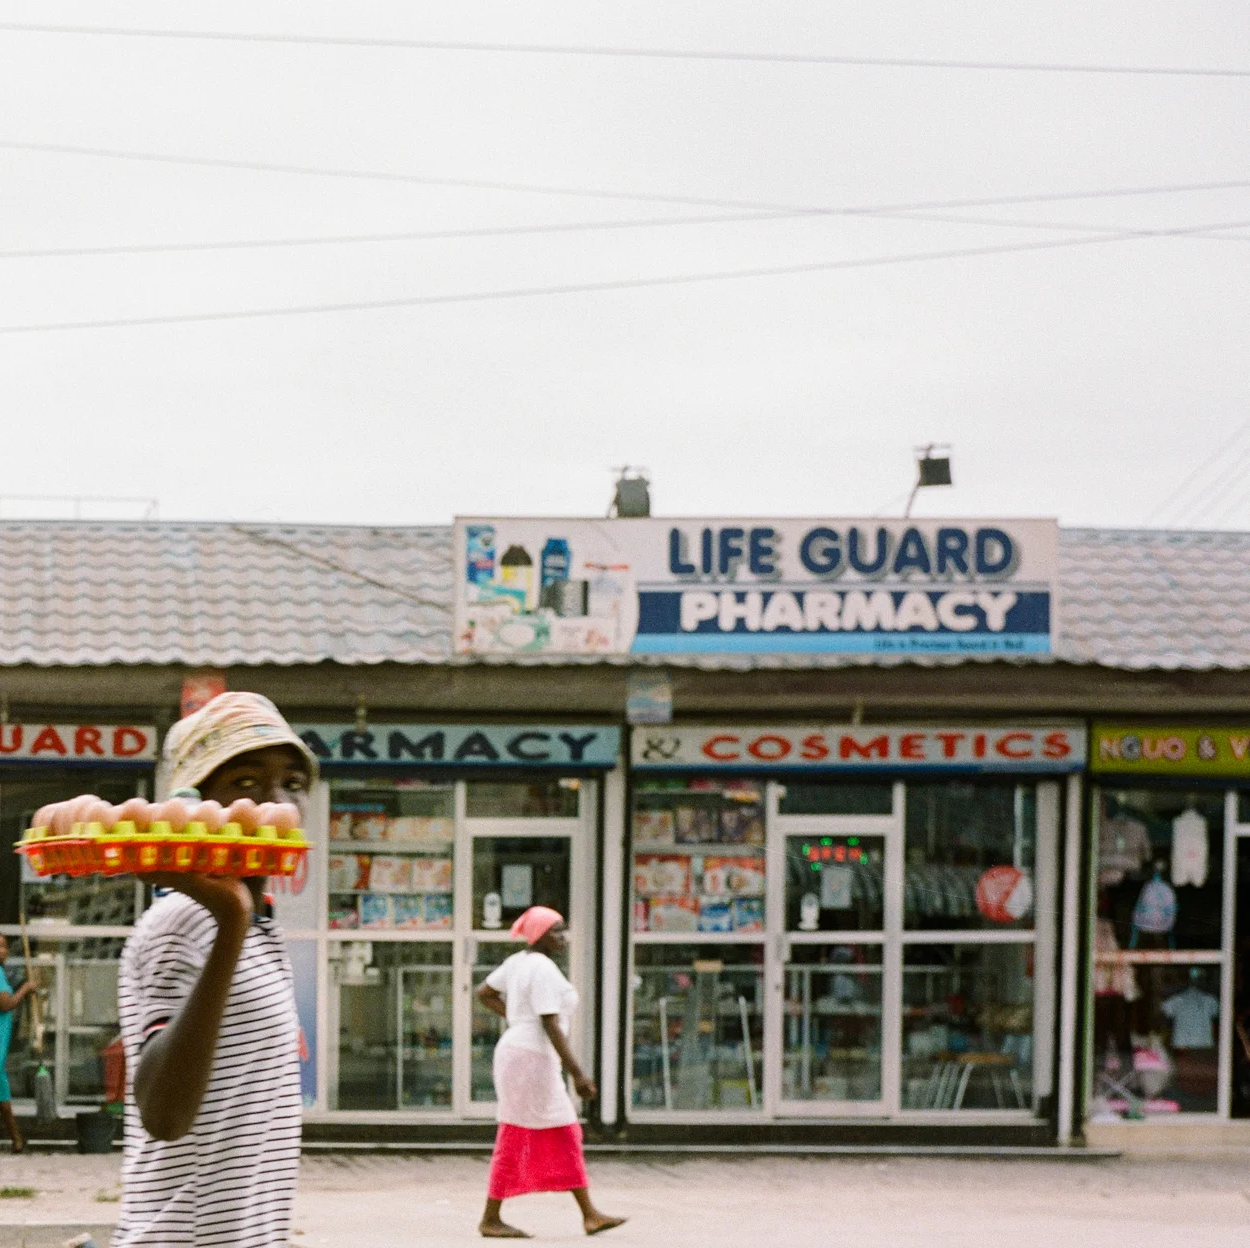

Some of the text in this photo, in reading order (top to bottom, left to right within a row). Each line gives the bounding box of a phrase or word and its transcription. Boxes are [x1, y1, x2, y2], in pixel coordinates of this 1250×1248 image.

[668, 526, 1015, 577] LIFE GUARD
[680, 590, 1019, 633] PHARMACY
[701, 732, 1072, 761] COSMETICS
[1199, 735, 1217, 760] &
